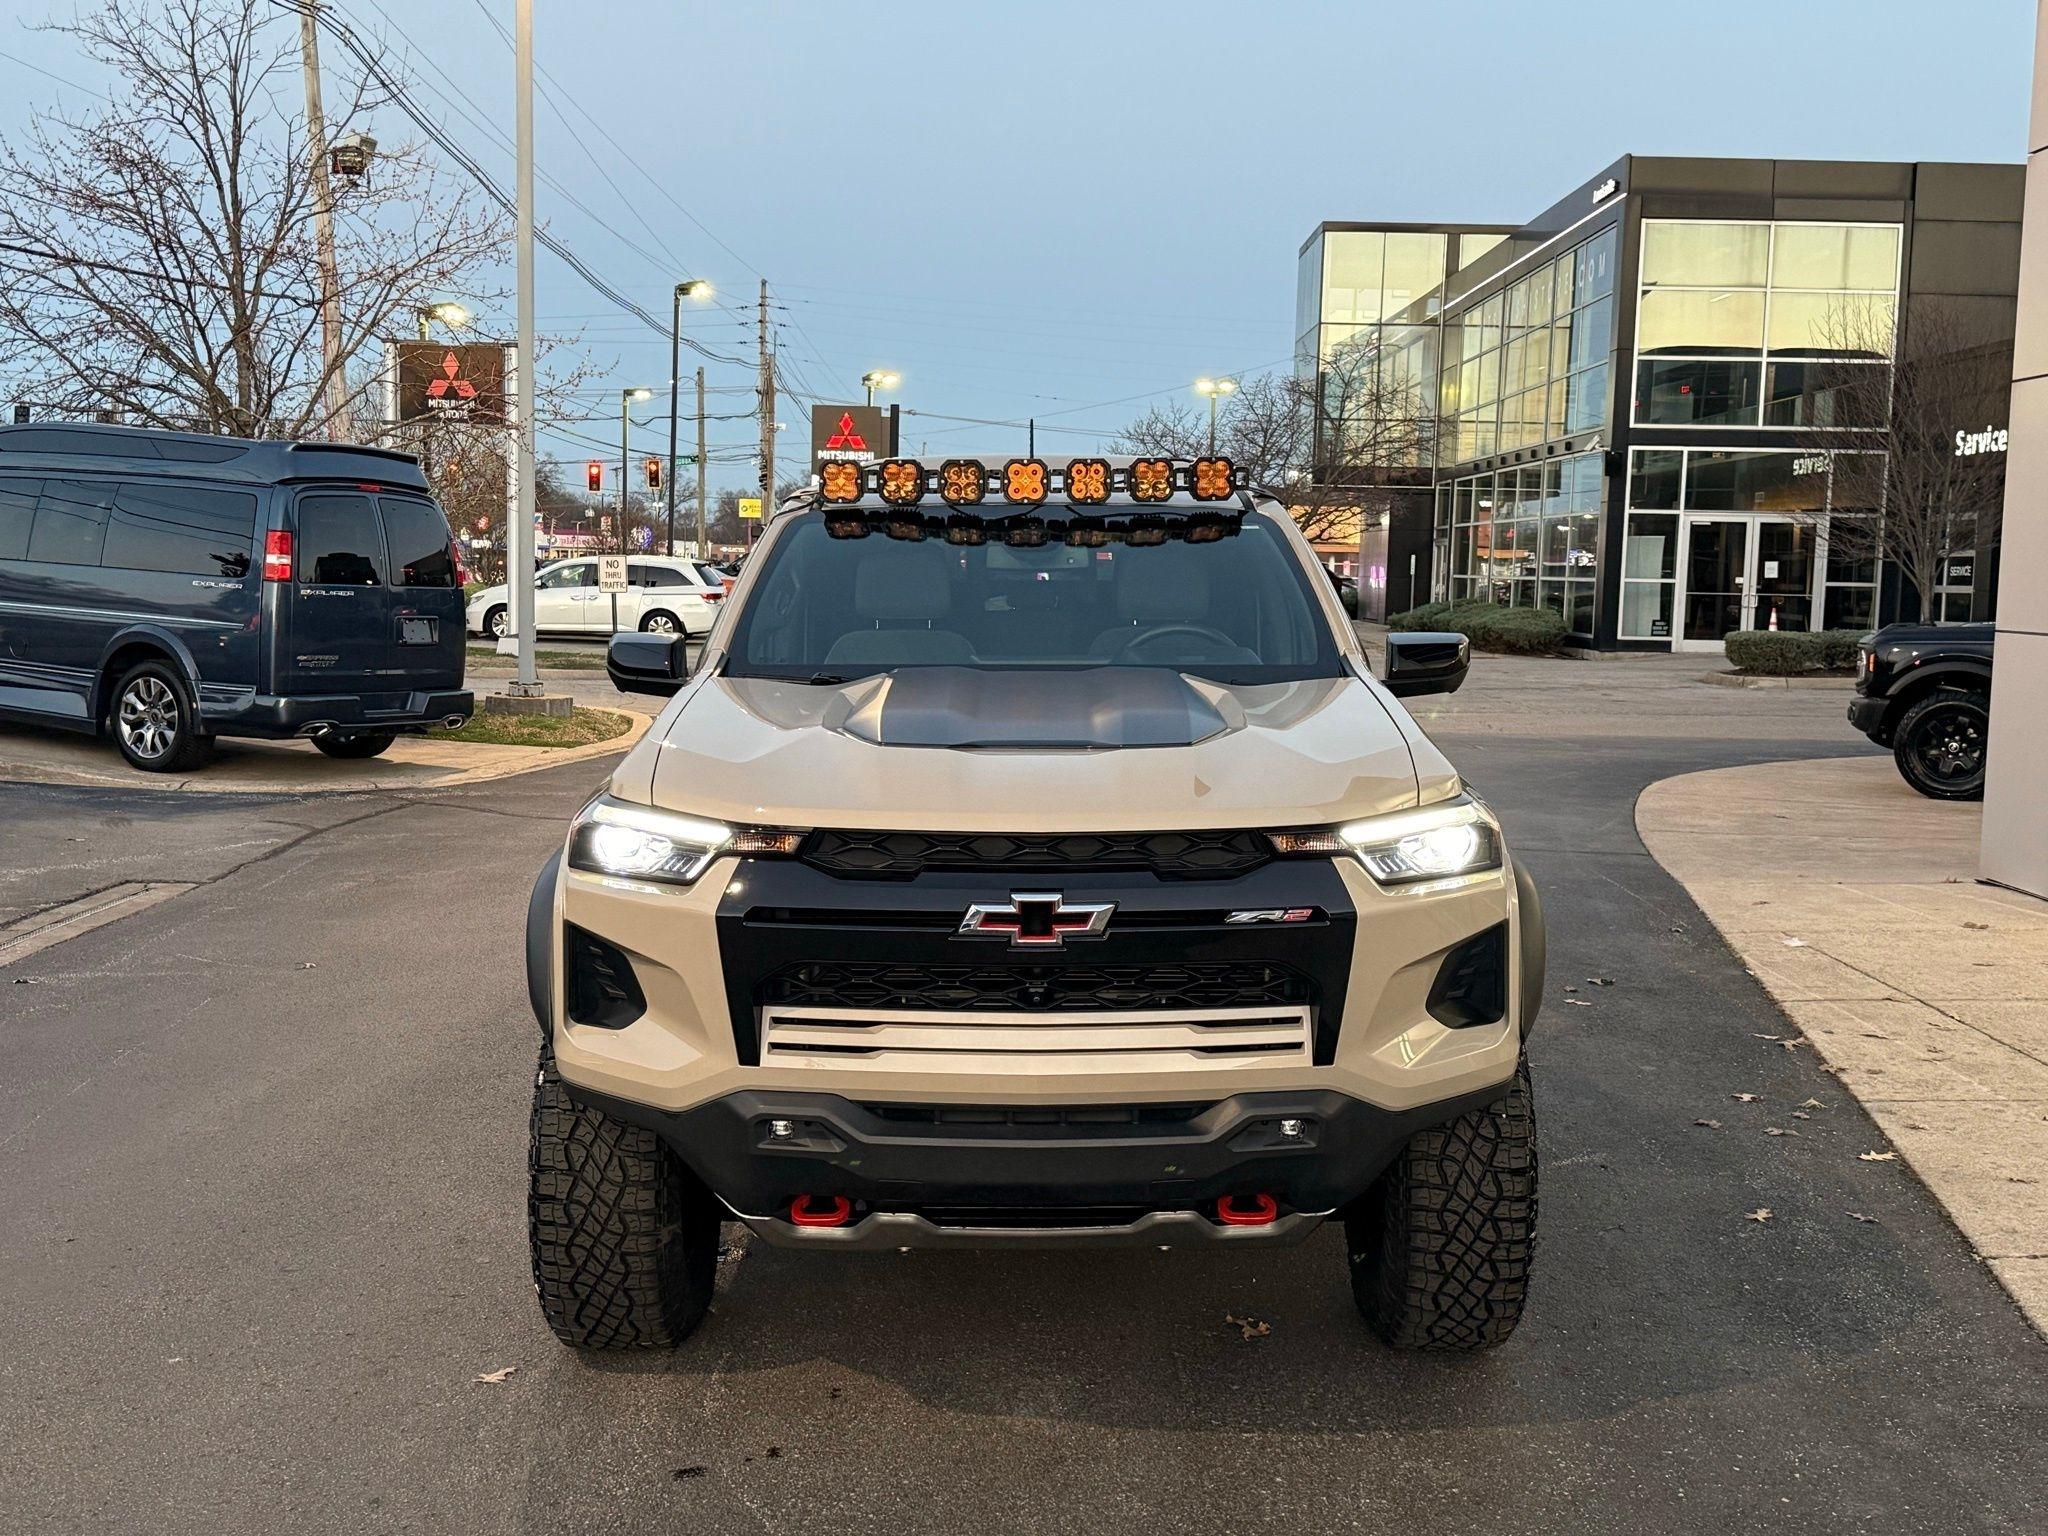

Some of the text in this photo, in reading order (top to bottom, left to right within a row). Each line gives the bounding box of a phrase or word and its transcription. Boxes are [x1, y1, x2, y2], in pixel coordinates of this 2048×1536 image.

[428, 399, 475, 410] MITSUBI
[435, 409, 469, 419] OTORS
[1955, 424, 2008, 456] Service
[817, 449, 875, 461] MITSUBISHI
[606, 559, 620, 569] NO
[605, 571, 622, 579] THRU
[1950, 565, 1972, 576] SERVICE
[601, 581, 626, 589] TRAFFIC
[1224, 909, 1313, 924] ZR2
